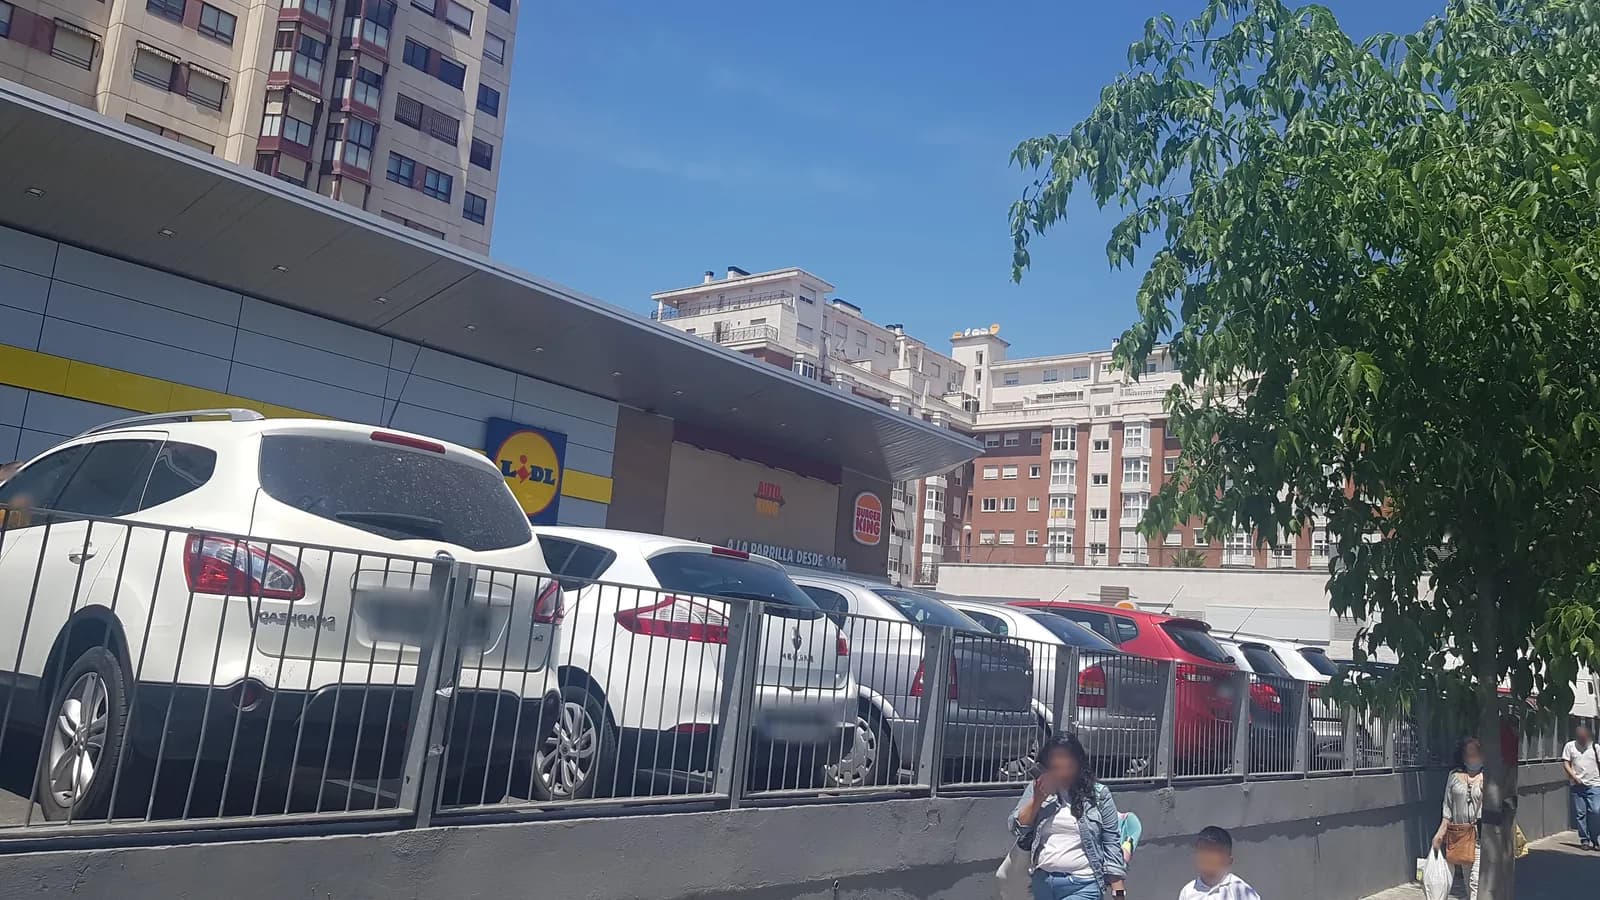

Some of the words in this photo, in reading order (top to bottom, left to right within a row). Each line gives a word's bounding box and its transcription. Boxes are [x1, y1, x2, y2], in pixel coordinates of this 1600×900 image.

[501, 455, 556, 485] LIDL
[758, 480, 781, 498] AUTO
[856, 506, 881, 521] BURGER
[856, 517, 880, 536] KING
[751, 542, 793, 563] PARRILLA
[796, 550, 823, 567] DESDE
